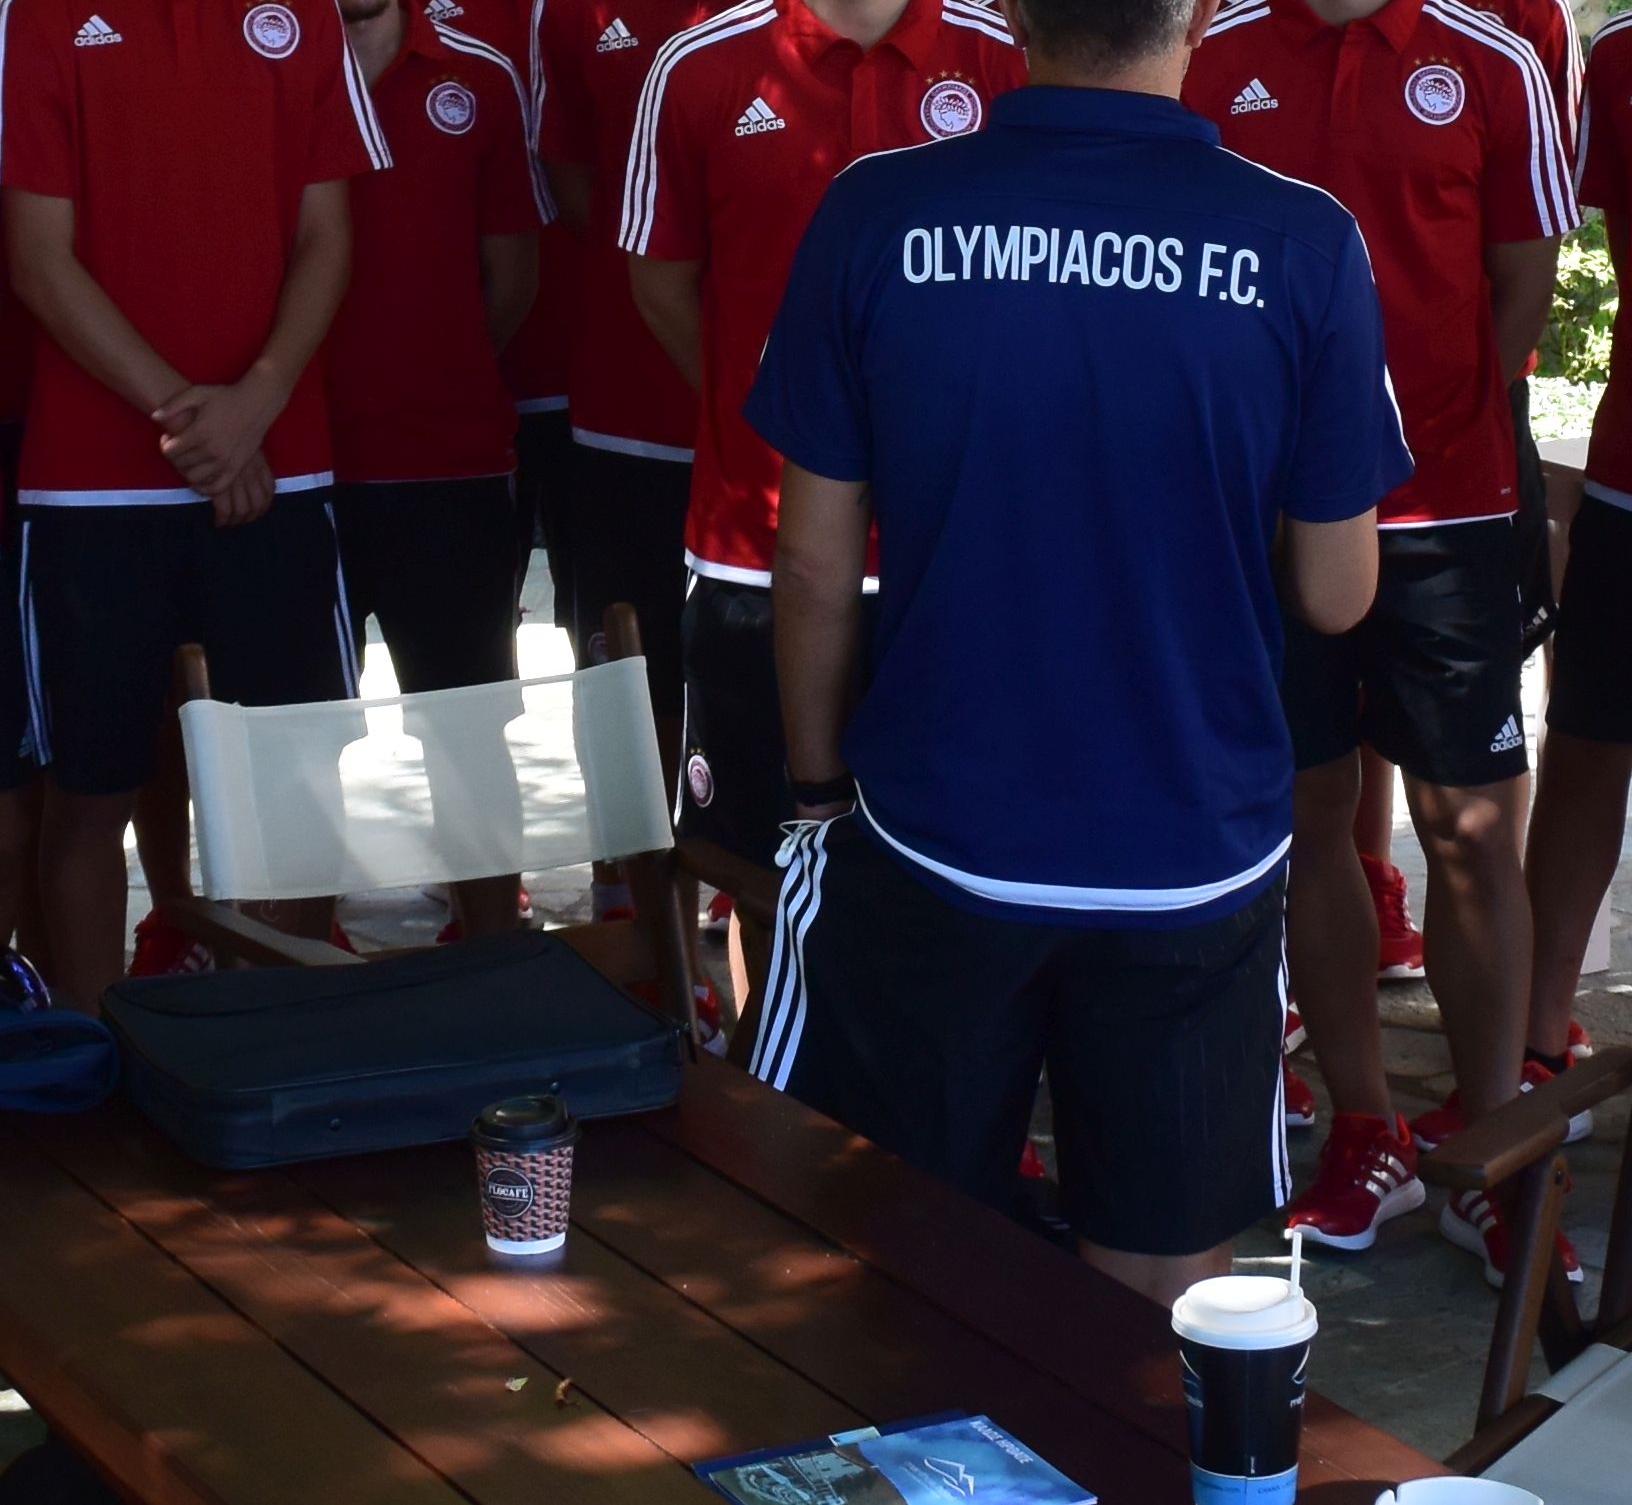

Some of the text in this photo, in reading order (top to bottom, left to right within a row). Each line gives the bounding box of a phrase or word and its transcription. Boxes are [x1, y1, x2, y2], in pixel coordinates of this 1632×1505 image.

[429, 6, 465, 22] didas
[74, 33, 123, 47] adidas
[596, 37, 639, 52] adidas
[1230, 96, 1279, 115] adidas
[734, 118, 786, 136] adidas
[903, 225, 1265, 308] OLYMPIACOS F.C.
